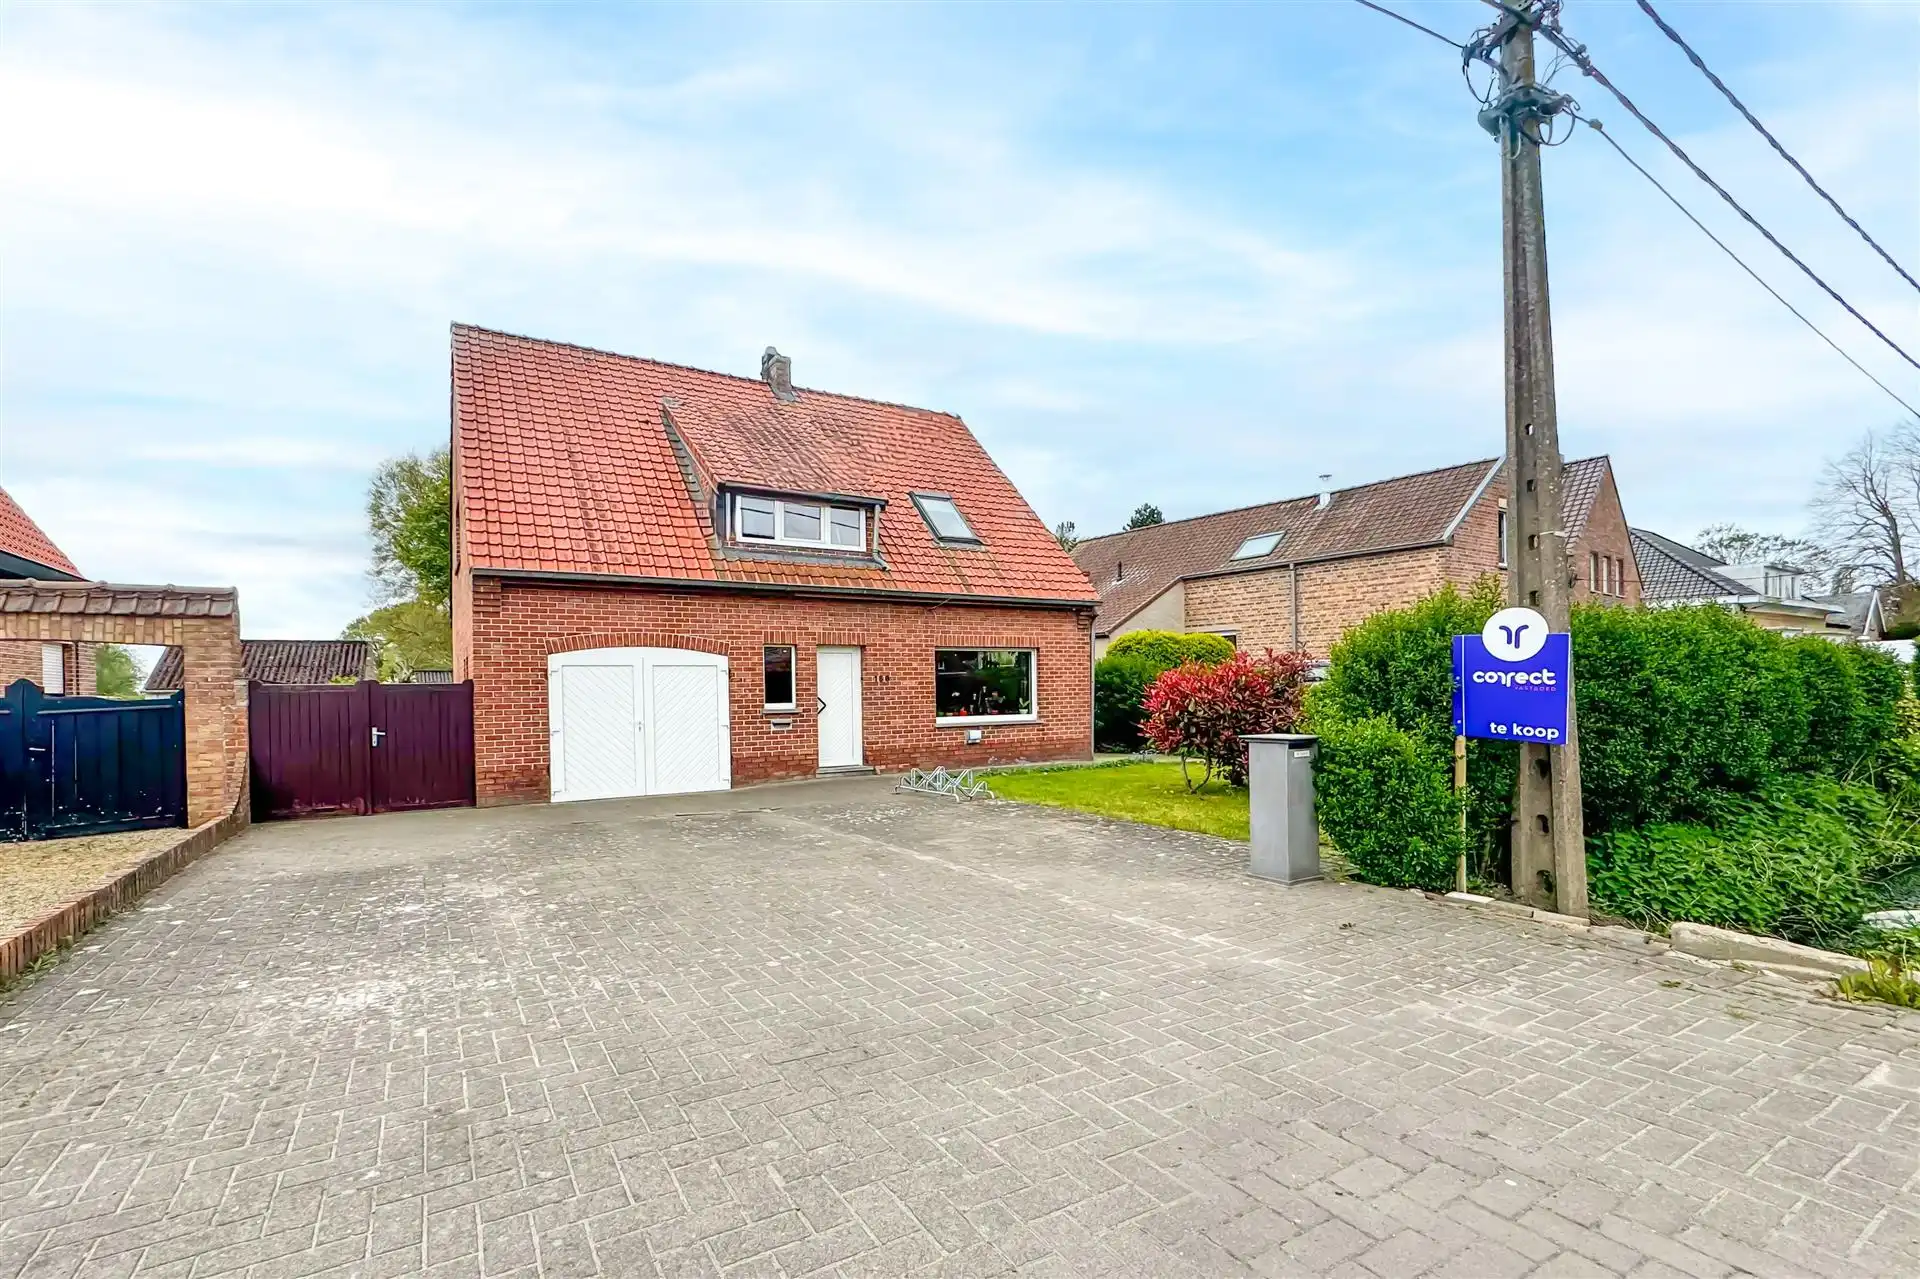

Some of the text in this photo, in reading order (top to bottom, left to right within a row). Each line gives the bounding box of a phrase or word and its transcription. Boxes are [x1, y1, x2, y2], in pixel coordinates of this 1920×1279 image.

[1472, 668, 1557, 688] correct
[1489, 722, 1559, 740] te koop
